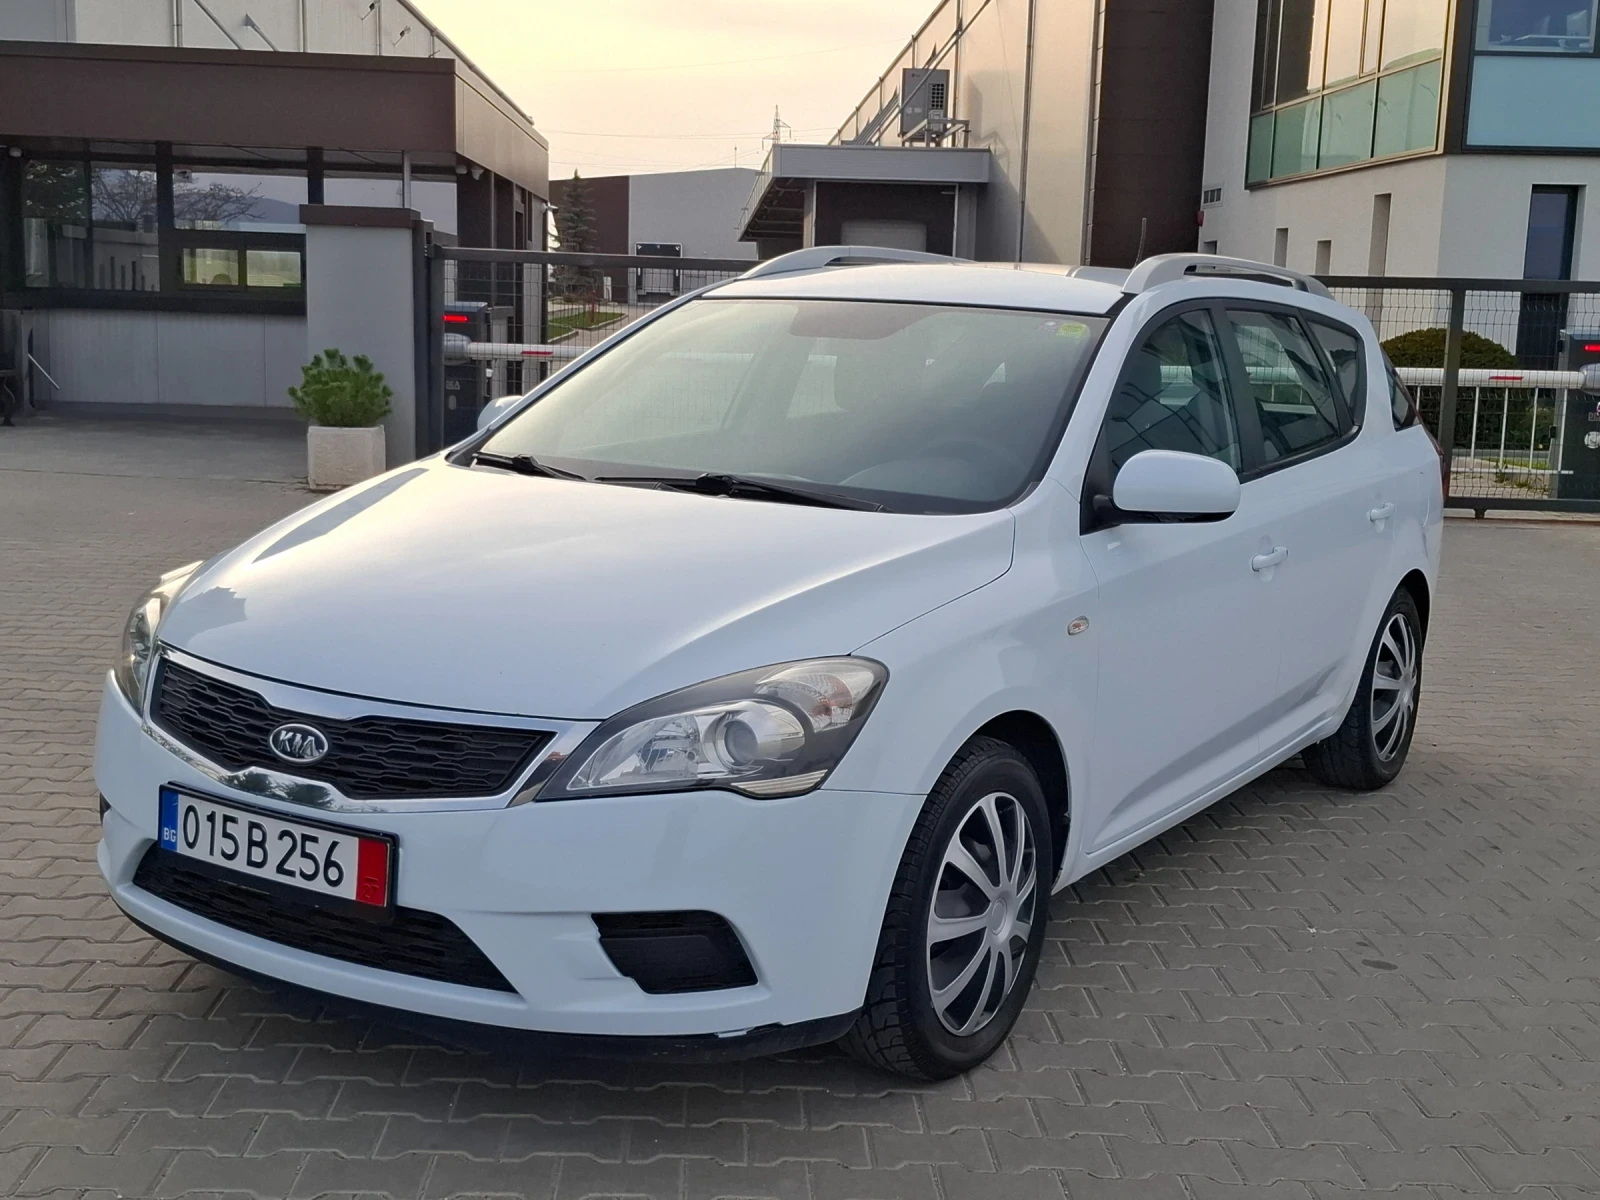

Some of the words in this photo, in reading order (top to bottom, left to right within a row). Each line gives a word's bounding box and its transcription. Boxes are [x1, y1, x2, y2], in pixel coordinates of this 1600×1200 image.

[278, 731, 320, 758] KIA
[163, 827, 176, 843] BG
[183, 804, 344, 888] 015B256
